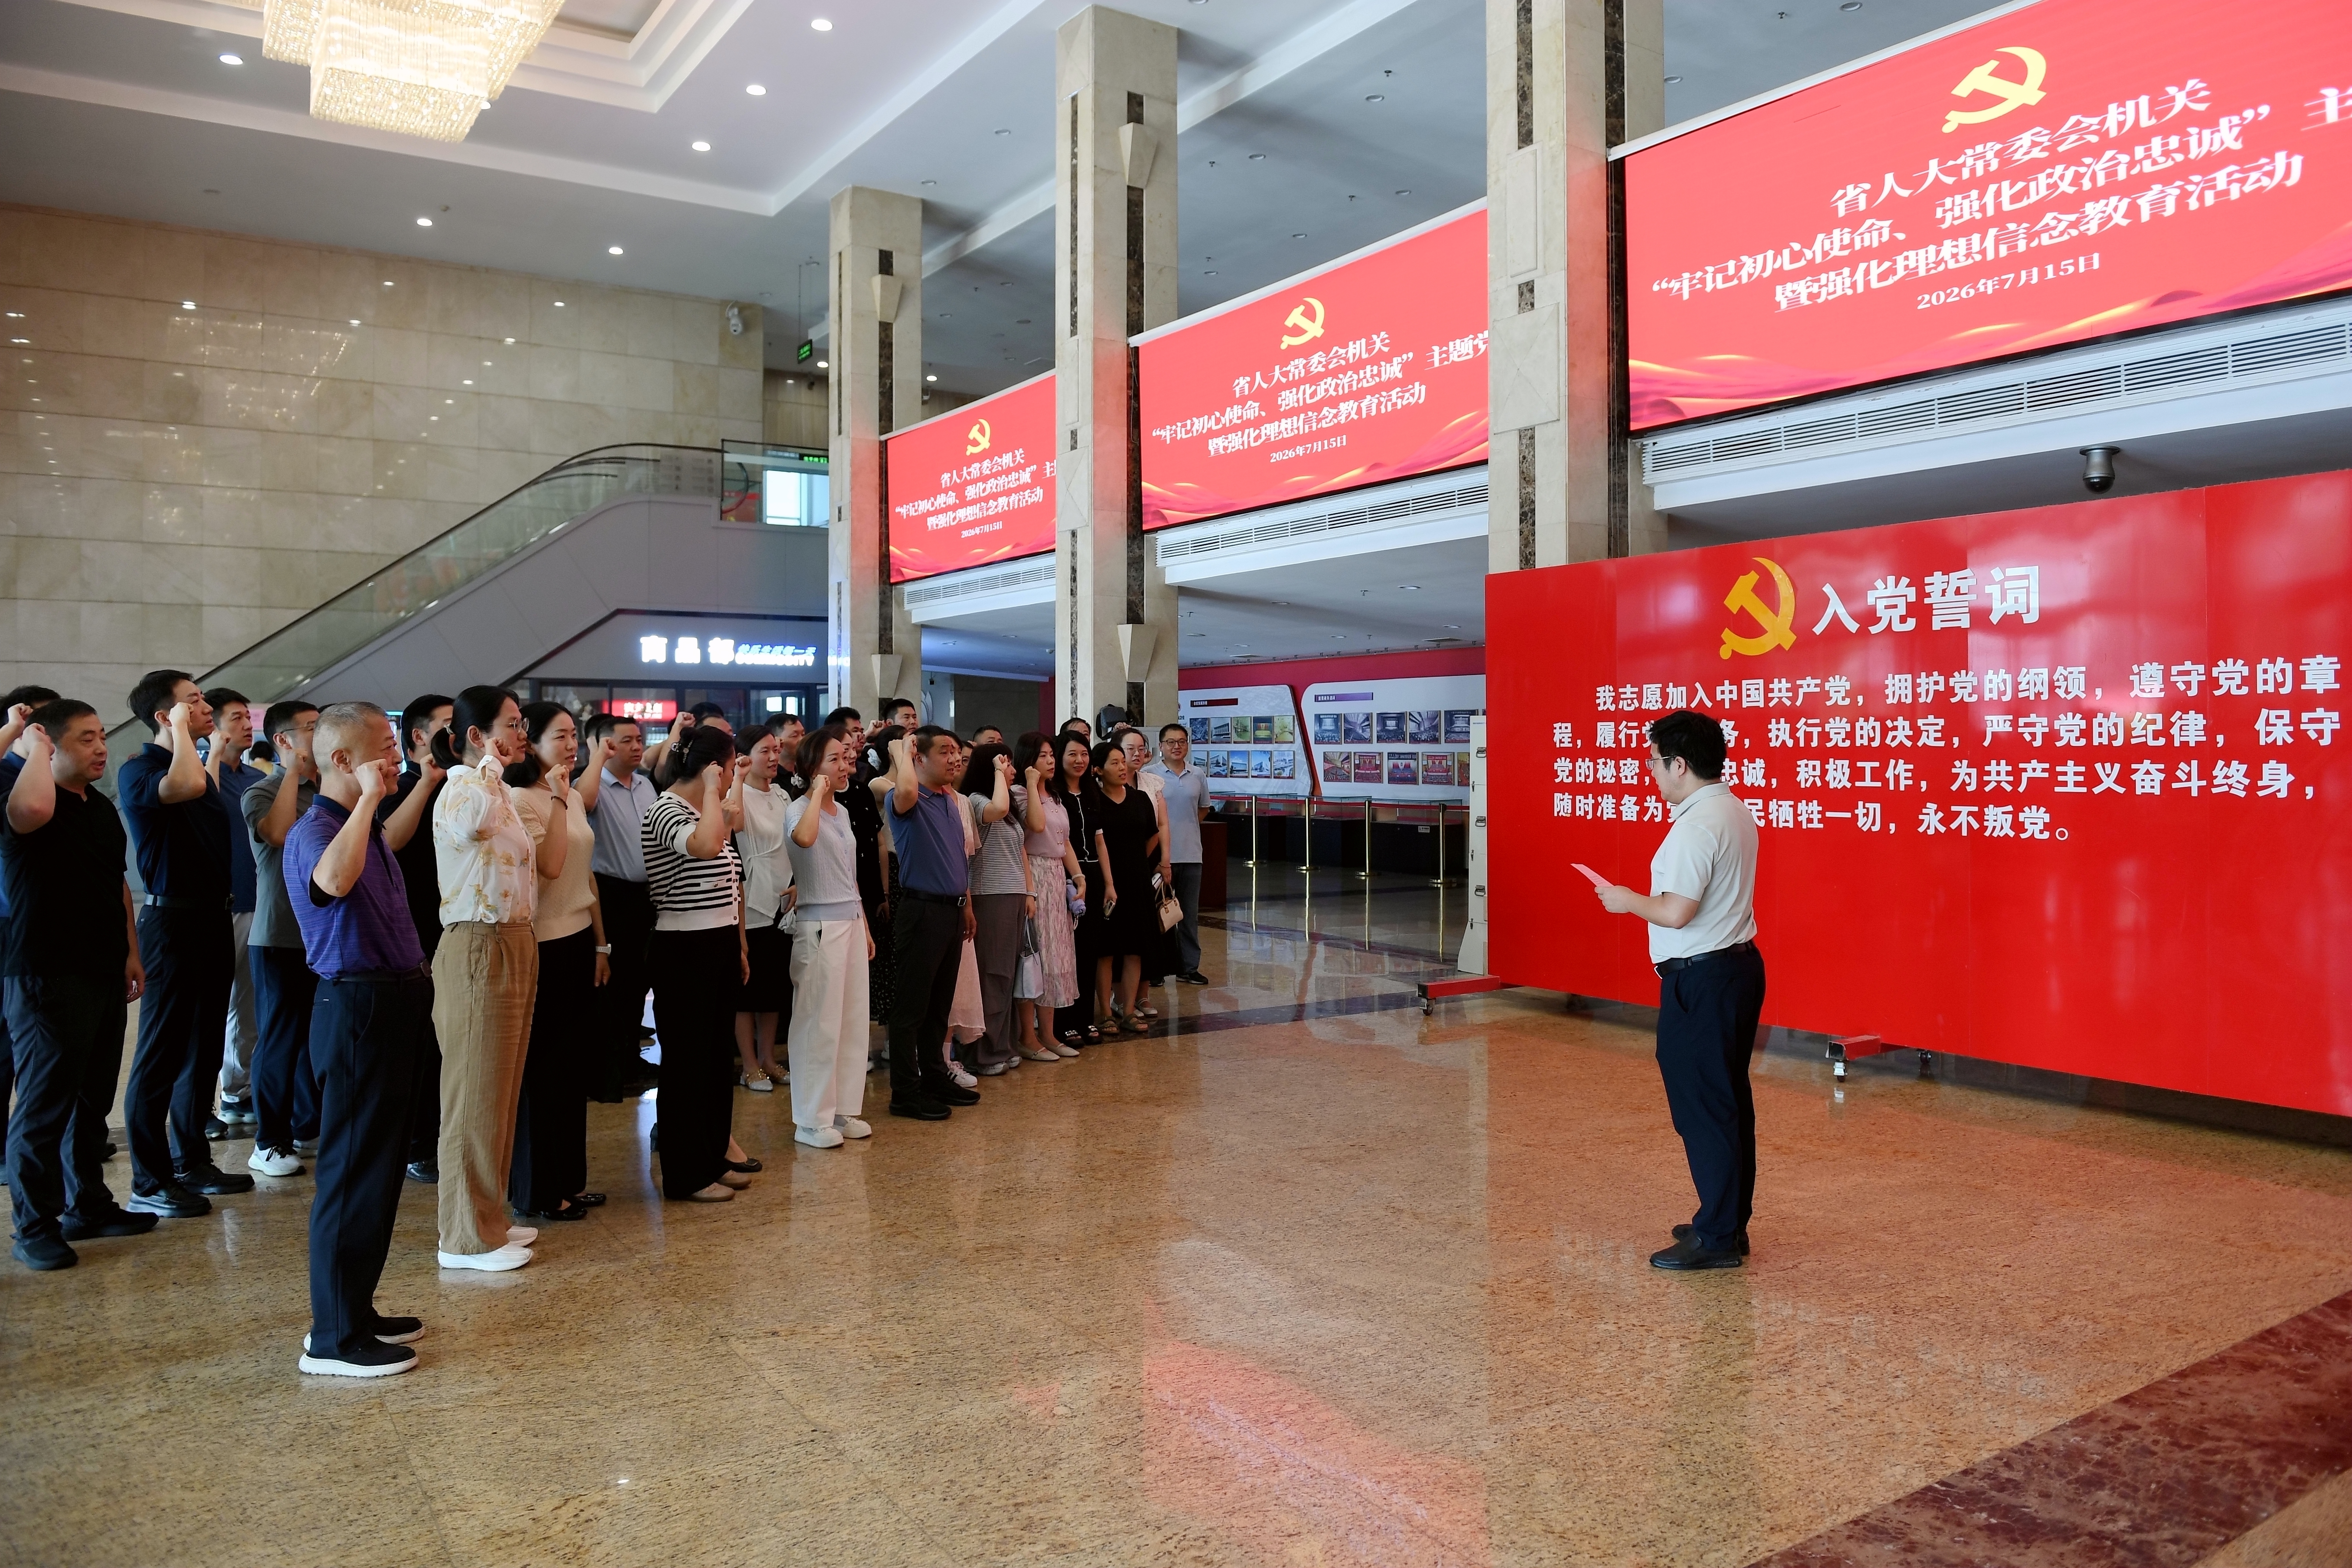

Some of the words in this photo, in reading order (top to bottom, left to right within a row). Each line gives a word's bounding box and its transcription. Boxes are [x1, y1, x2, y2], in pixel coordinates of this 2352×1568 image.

[1830, 78, 2212, 219] 省人大常委会机关
[1774, 150, 2304, 314] 暨强化理想信念教育活动
[1916, 253, 2101, 311] 2026年7月15日
[1232, 331, 1391, 399] 省人大常委会机关
[1208, 382, 1426, 457] 暨强化理想信念教育活动
[940, 448, 1025, 489] 省人大常委会机关
[1270, 435, 1346, 463] 2026年7月15日
[895, 459, 1057, 519] “牢记初心使命、强化政治忠诚”主
[927, 486, 1044, 531] 暨强化理想信念教育活动
[960, 521, 1002, 538] 2026年7月15日
[1812, 564, 2040, 635] 入党誓词
[1596, 655, 2341, 712] 我志愿加入中国共产党，拥护党的纲领，遵守党的章
[1553, 707, 2341, 748] 程，履行务，执行党的决定，严守党的纪律，保守
[1553, 757, 2315, 800] 党的秘密，忠诚，积极工作，为共产主义奋斗终身，
[1553, 792, 2070, 841] 随时准备为民牺牲一切，永不叛党。
